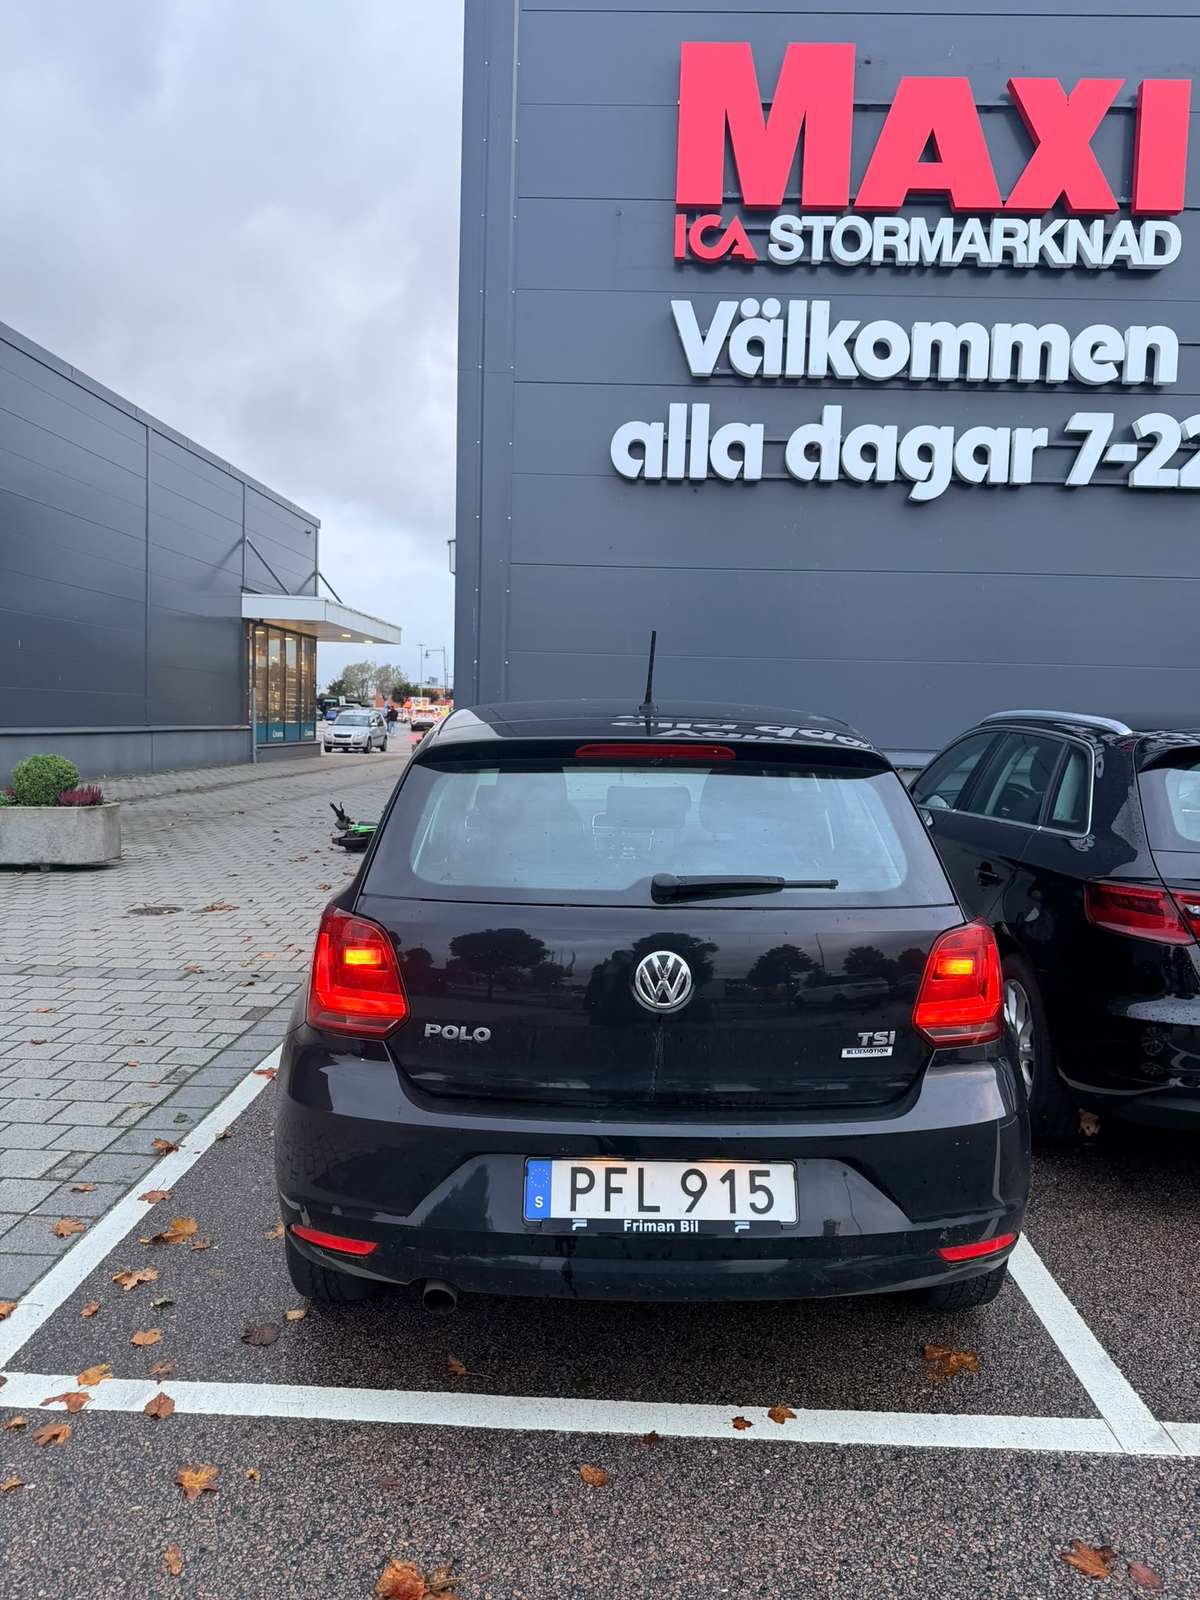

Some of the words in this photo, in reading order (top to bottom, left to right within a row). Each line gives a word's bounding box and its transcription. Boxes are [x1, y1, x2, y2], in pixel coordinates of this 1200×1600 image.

[674, 213, 757, 265] ICA
[767, 214, 1183, 271] STORMARKNAD
[670, 297, 1180, 385] Välkommen
[609, 402, 765, 482] alla
[784, 404, 1049, 502] dagar
[424, 1022, 492, 1042] POLO
[857, 1030, 896, 1046] TSI
[534, 1195, 544, 1209] S
[569, 1166, 661, 1213] PFL
[680, 1168, 774, 1215] 915
[623, 1219, 676, 1233] Friman
[680, 1220, 699, 1233] Bil
